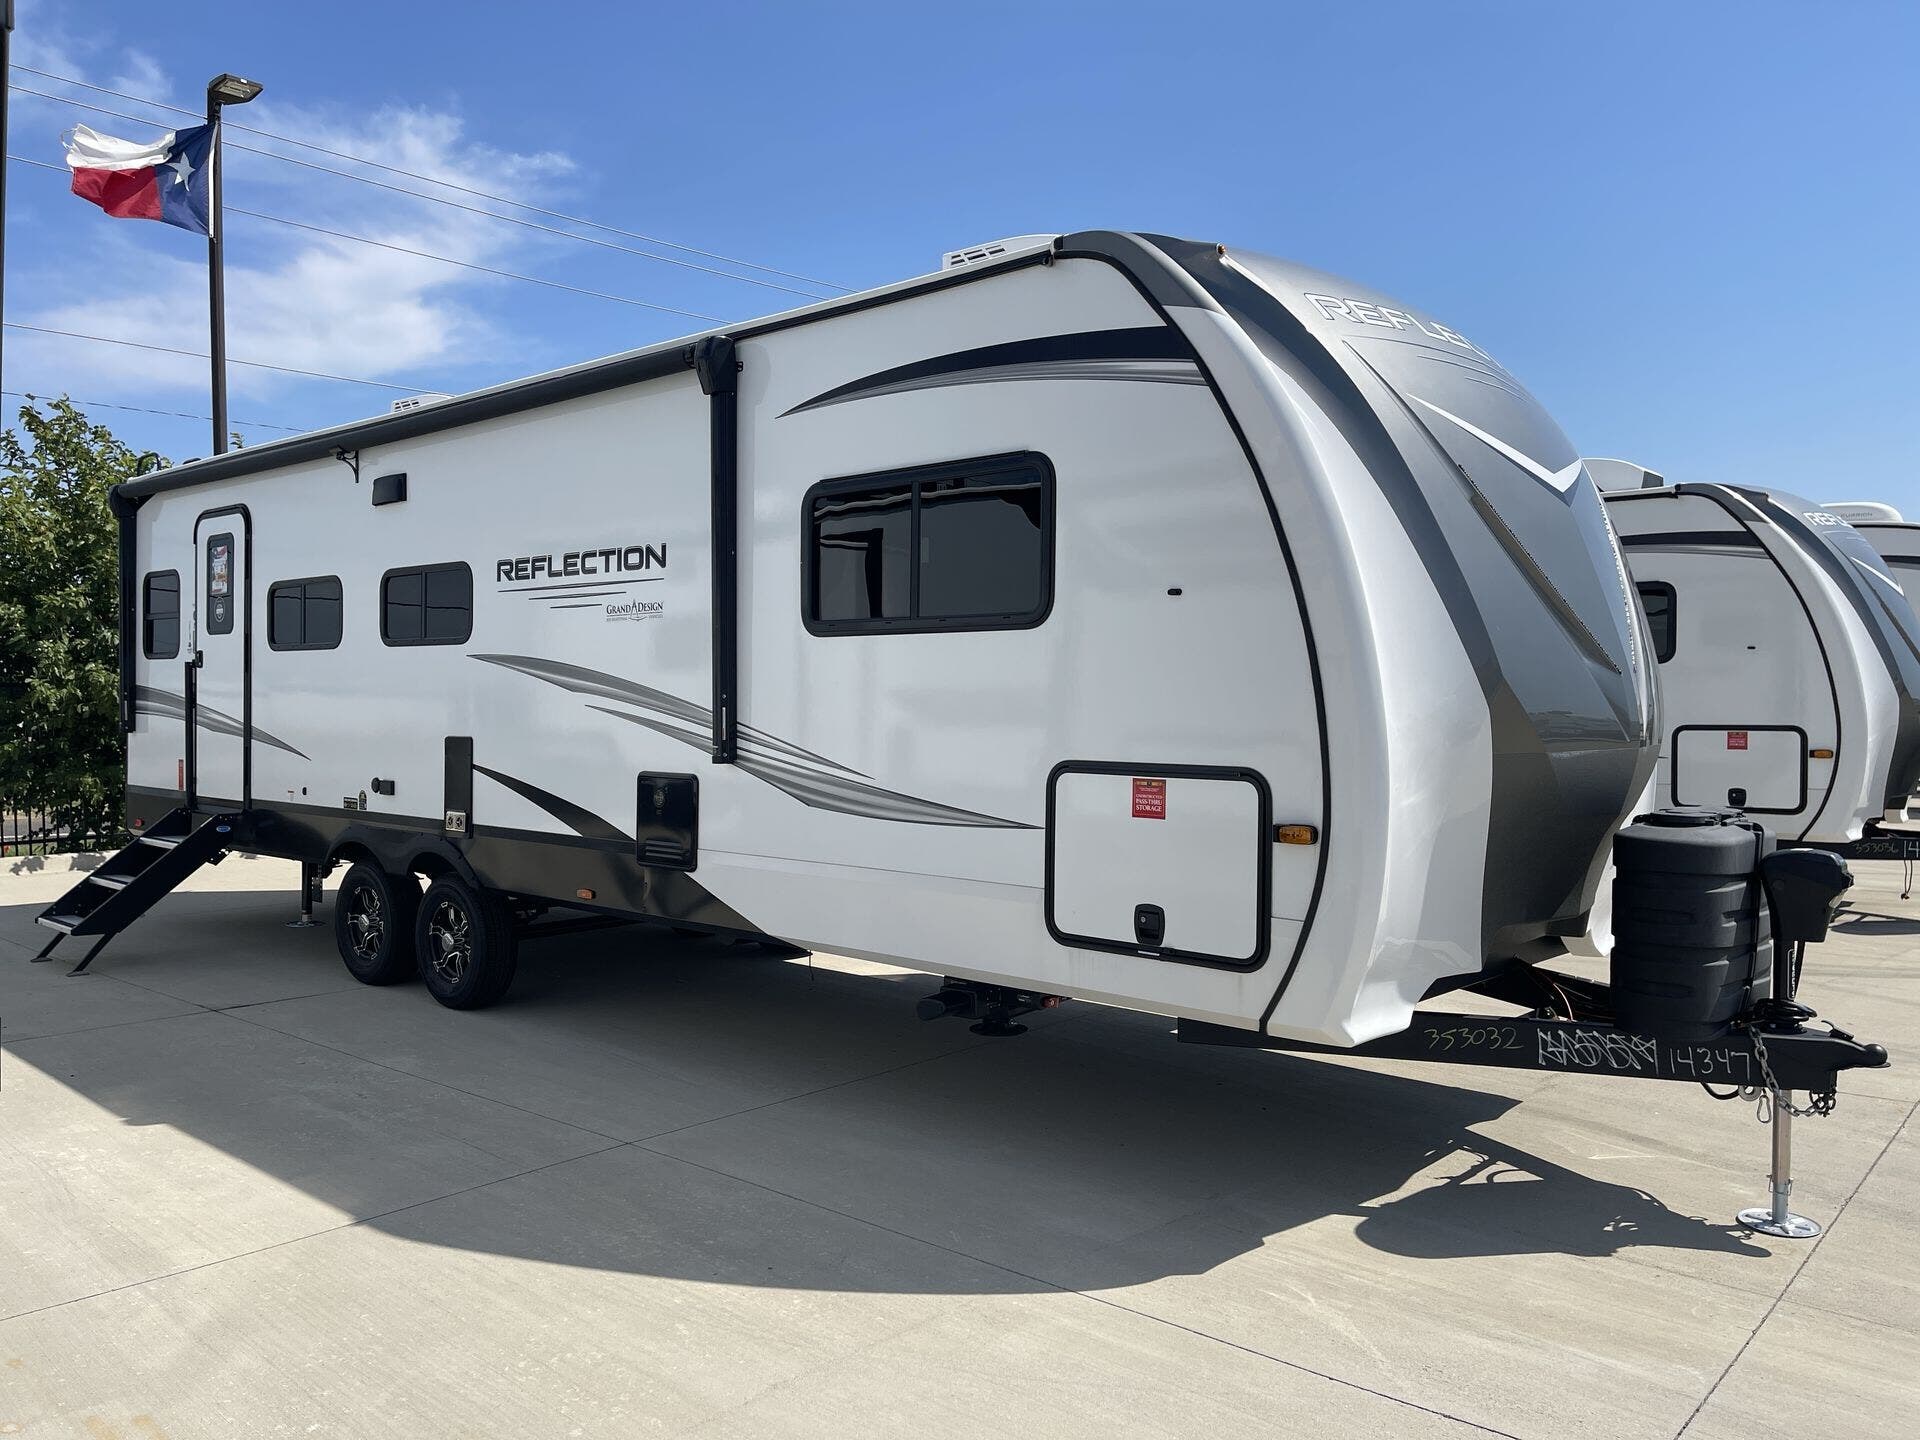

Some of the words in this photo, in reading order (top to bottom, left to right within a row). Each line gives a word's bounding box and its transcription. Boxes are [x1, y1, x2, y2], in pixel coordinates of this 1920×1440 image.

[496, 543, 667, 582] REFLECTION
[638, 601, 664, 613] DESIGN
[1135, 804, 1163, 812] STORAGE
[1423, 1026, 1524, 1051] 353032
[1669, 1046, 1751, 1080] 14347
